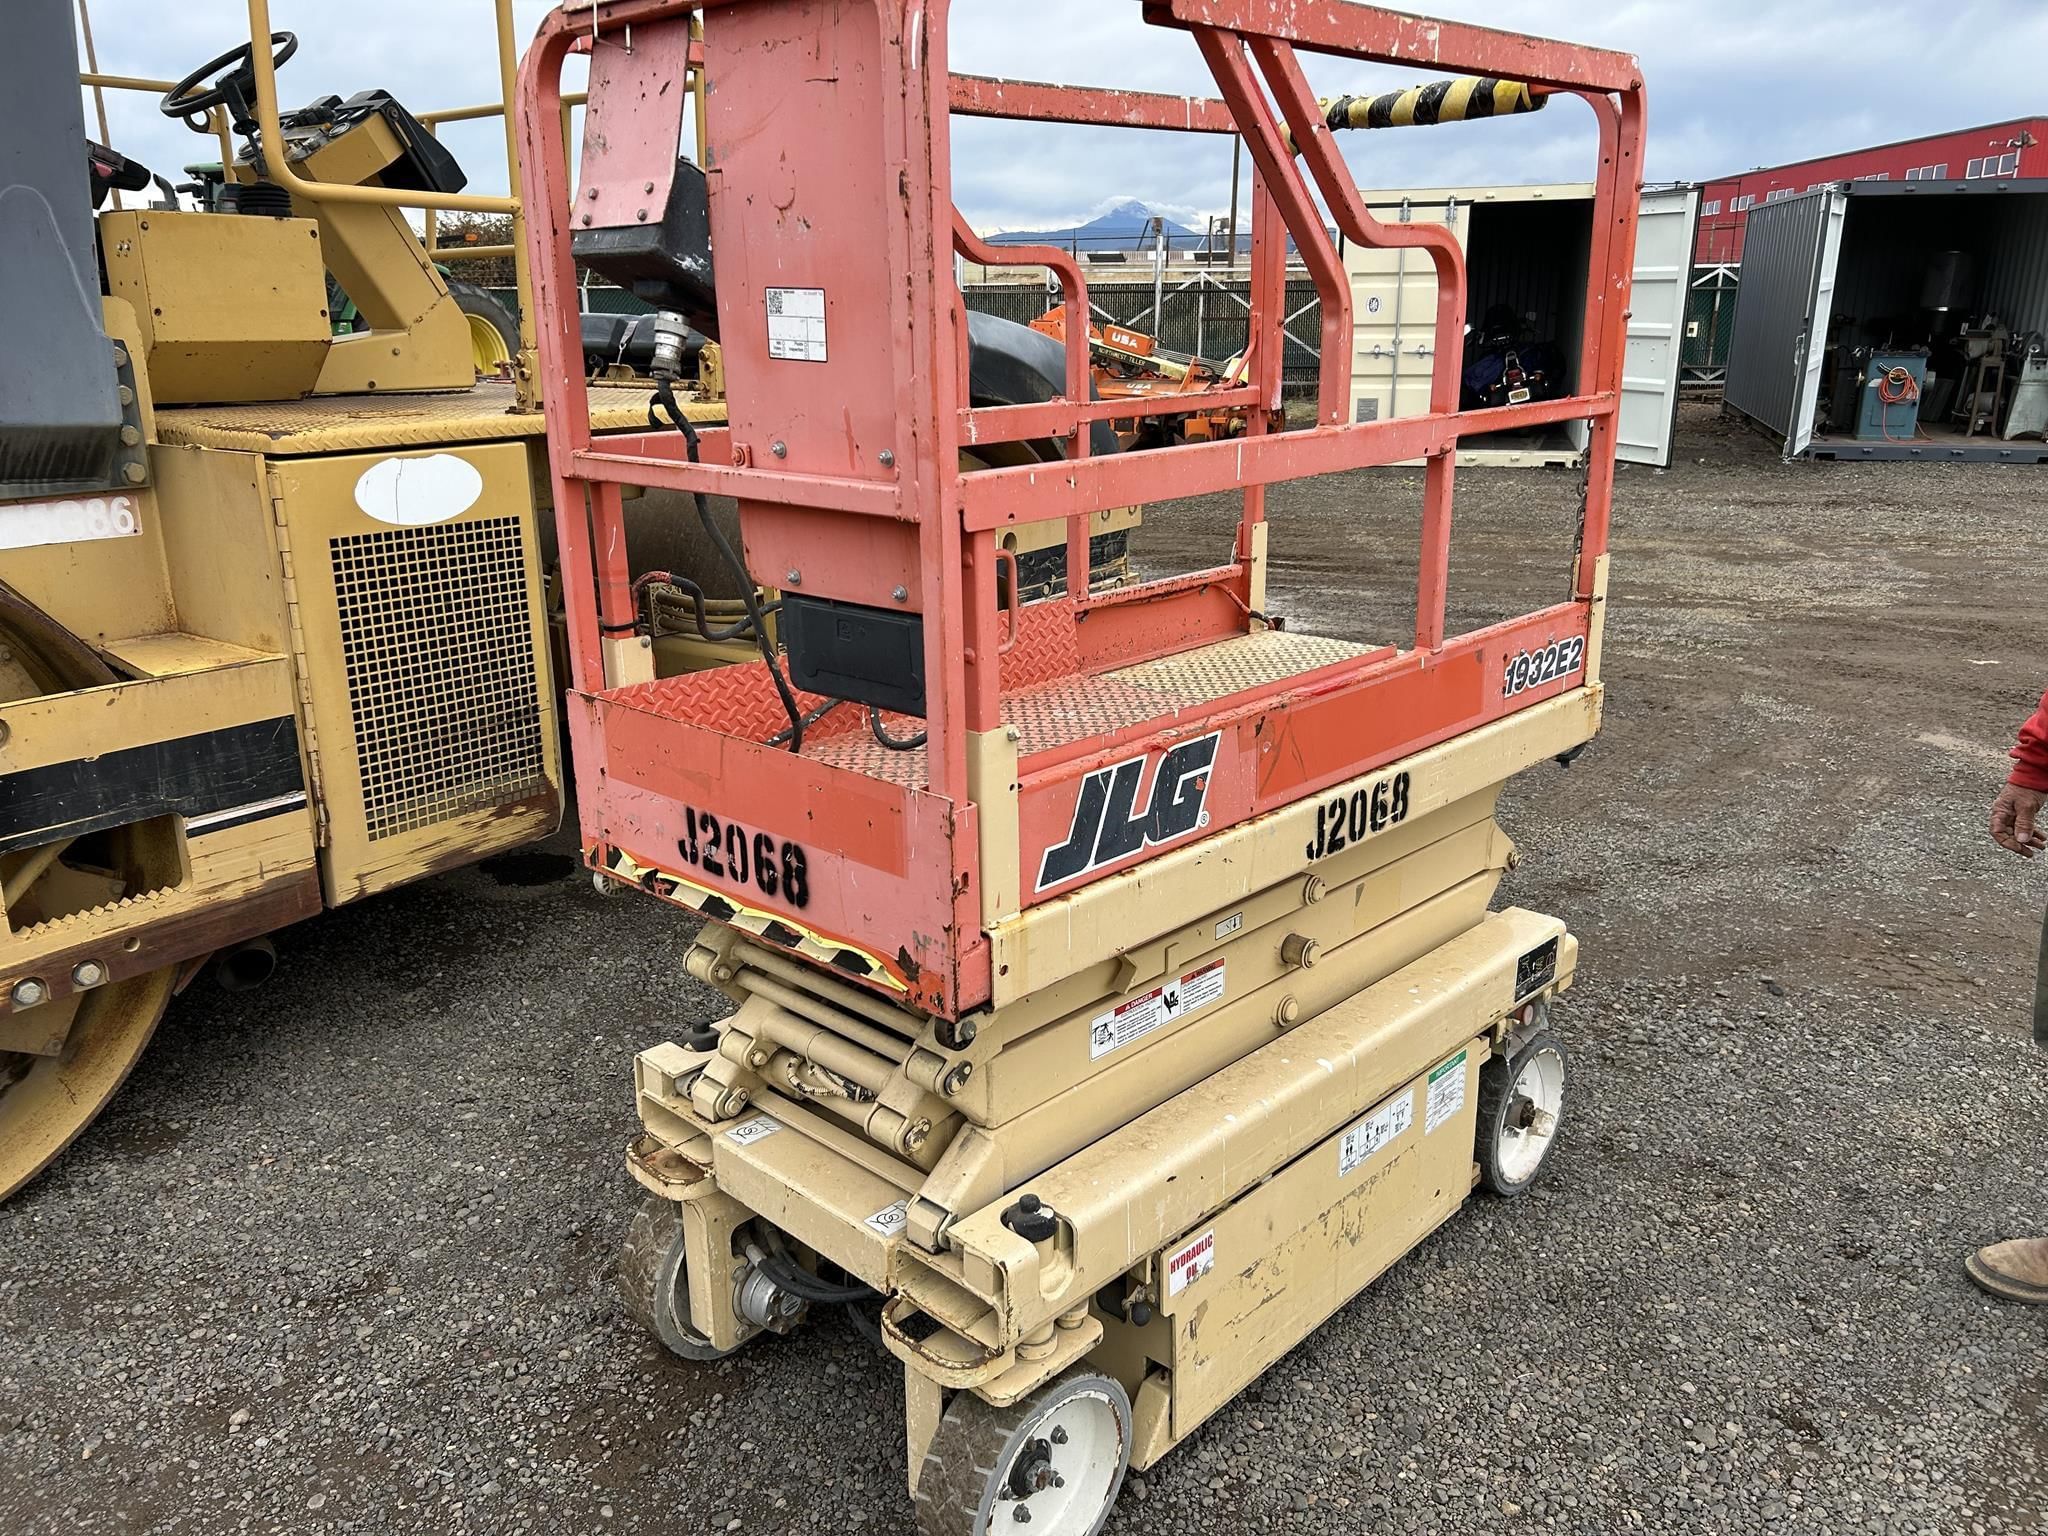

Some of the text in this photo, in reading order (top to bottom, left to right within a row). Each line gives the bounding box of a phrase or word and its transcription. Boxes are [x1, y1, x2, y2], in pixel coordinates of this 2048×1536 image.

[1098, 347, 1146, 366] NORTHWEST TILLER
[1111, 331, 1138, 348] USA
[1505, 636, 1585, 697] 1932E2
[1034, 730, 1222, 893] JLG
[1306, 771, 1409, 860] J2068
[677, 806, 809, 909] J2068
[1131, 993, 1152, 1007] DANGER
[1436, 1056, 1460, 1077] IMPORTANT
[1170, 1234, 1213, 1274] HYDRAULIC
